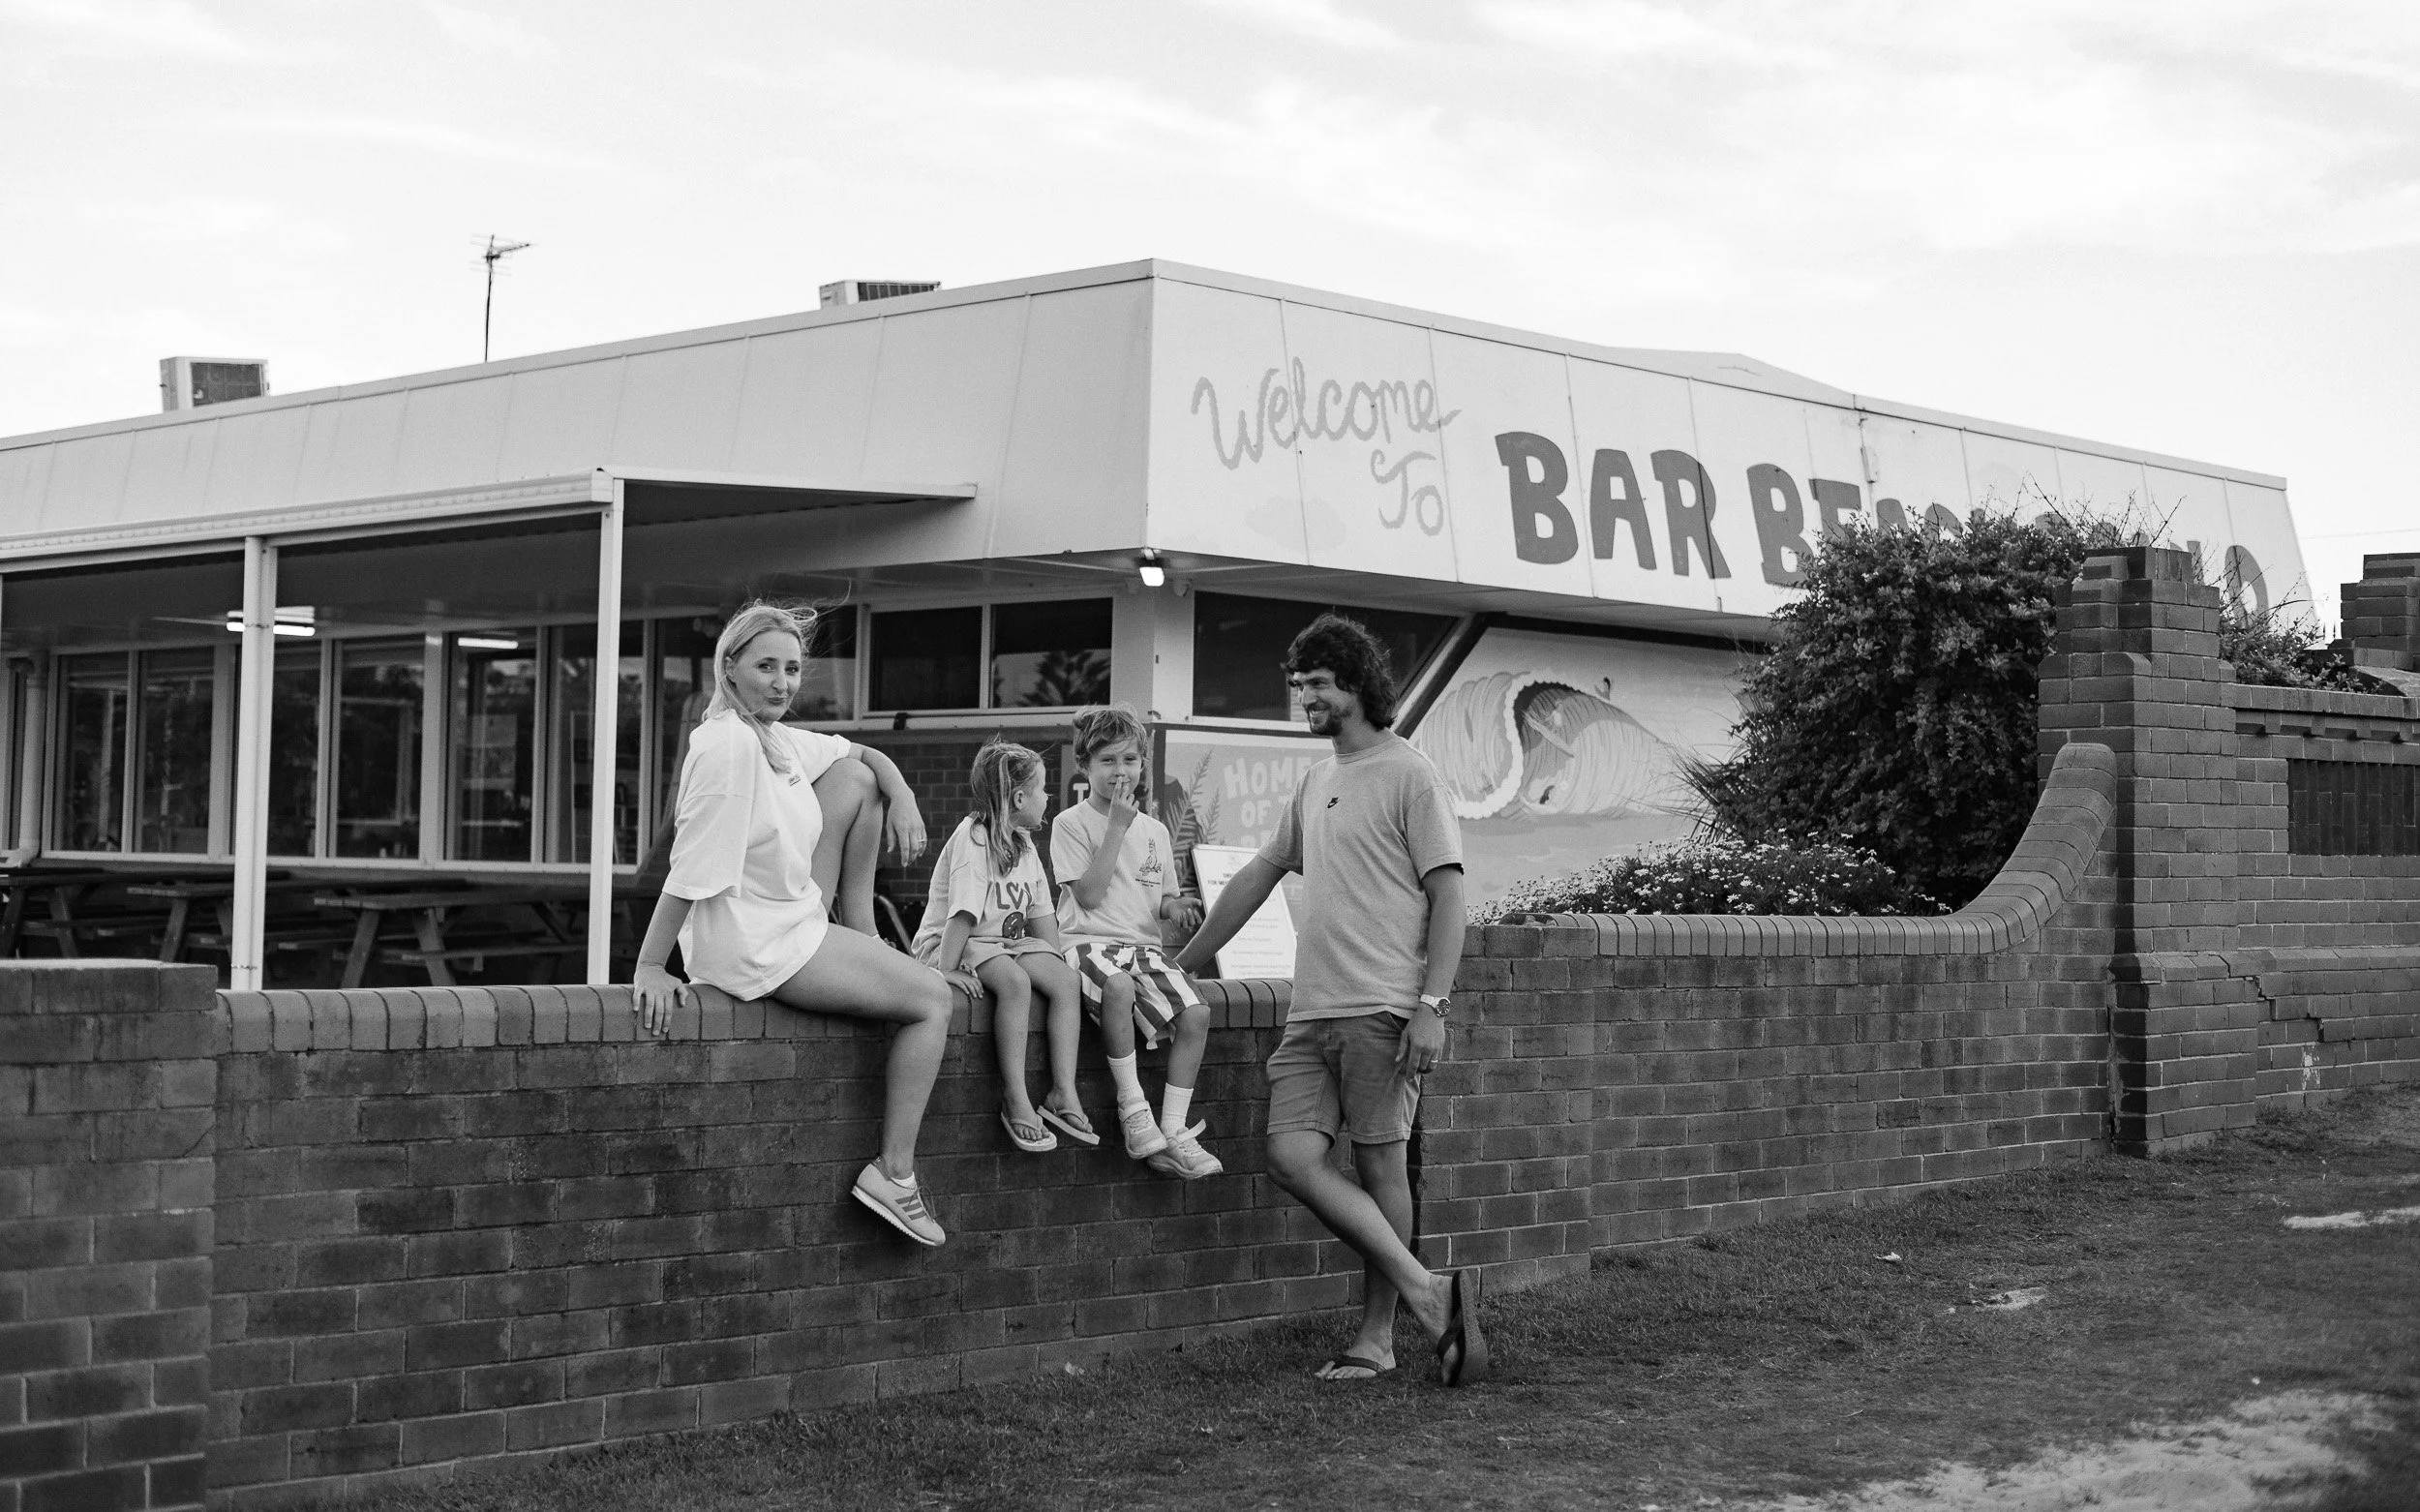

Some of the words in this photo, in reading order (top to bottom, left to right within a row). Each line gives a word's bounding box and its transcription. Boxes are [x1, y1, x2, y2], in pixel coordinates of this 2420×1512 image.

[1191, 356, 1462, 470] Welcome
[1370, 448, 1444, 536] To
[1495, 431, 1732, 580] BAR
[1240, 800, 1271, 828] OF
